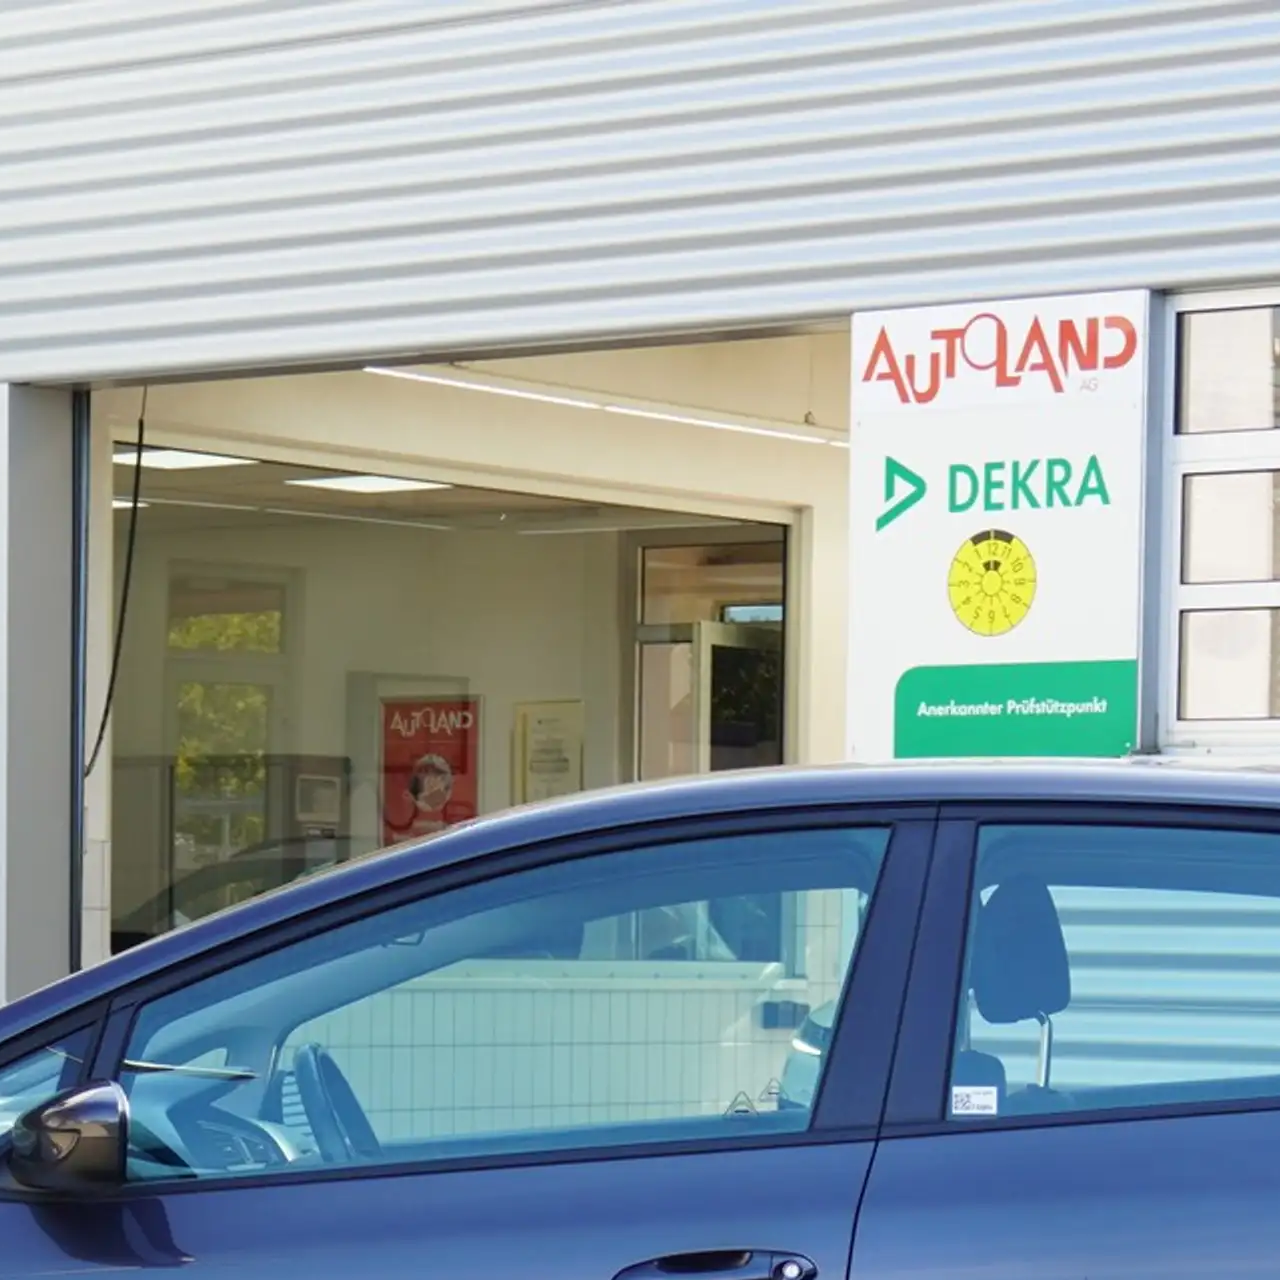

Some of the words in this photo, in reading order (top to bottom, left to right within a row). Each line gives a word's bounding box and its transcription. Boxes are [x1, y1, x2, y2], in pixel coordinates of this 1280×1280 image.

[862, 313, 1137, 404] AUTOLAND
[949, 454, 1110, 513] DEKRA
[390, 707, 473, 737] AUTOLAND
[917, 700, 1004, 717] Anerkannter
[1006, 696, 1109, 718] Prüfstützpunkt
